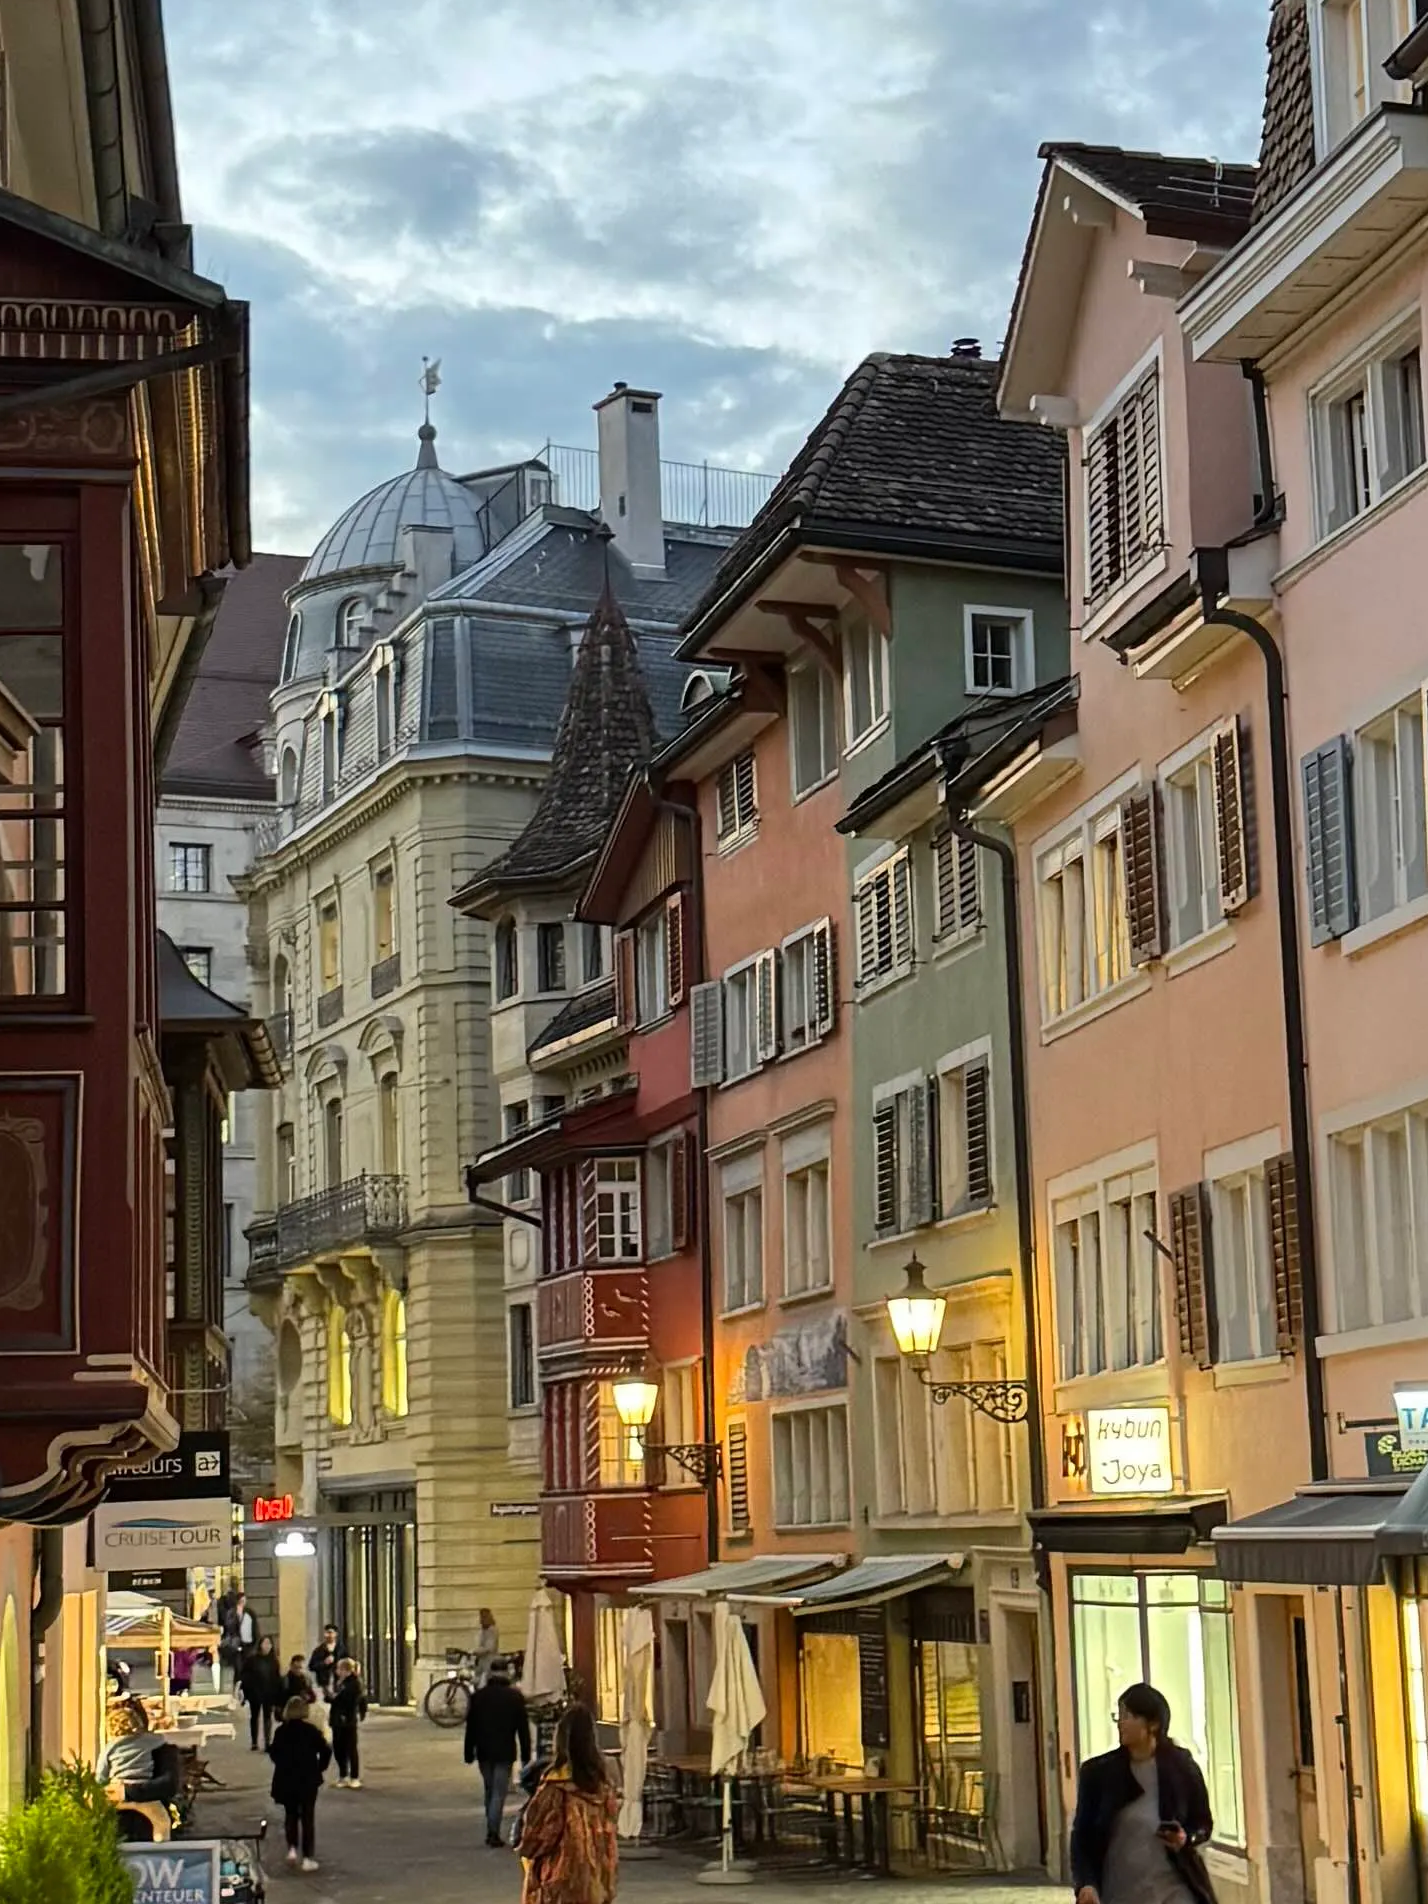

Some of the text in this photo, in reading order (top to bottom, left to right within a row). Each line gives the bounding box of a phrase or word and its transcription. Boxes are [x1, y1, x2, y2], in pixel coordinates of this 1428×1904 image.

[1097, 1417, 1162, 1440] kybun
[1101, 1458, 1162, 1486] Joya
[105, 1527, 221, 1547] CRUISETOUR
